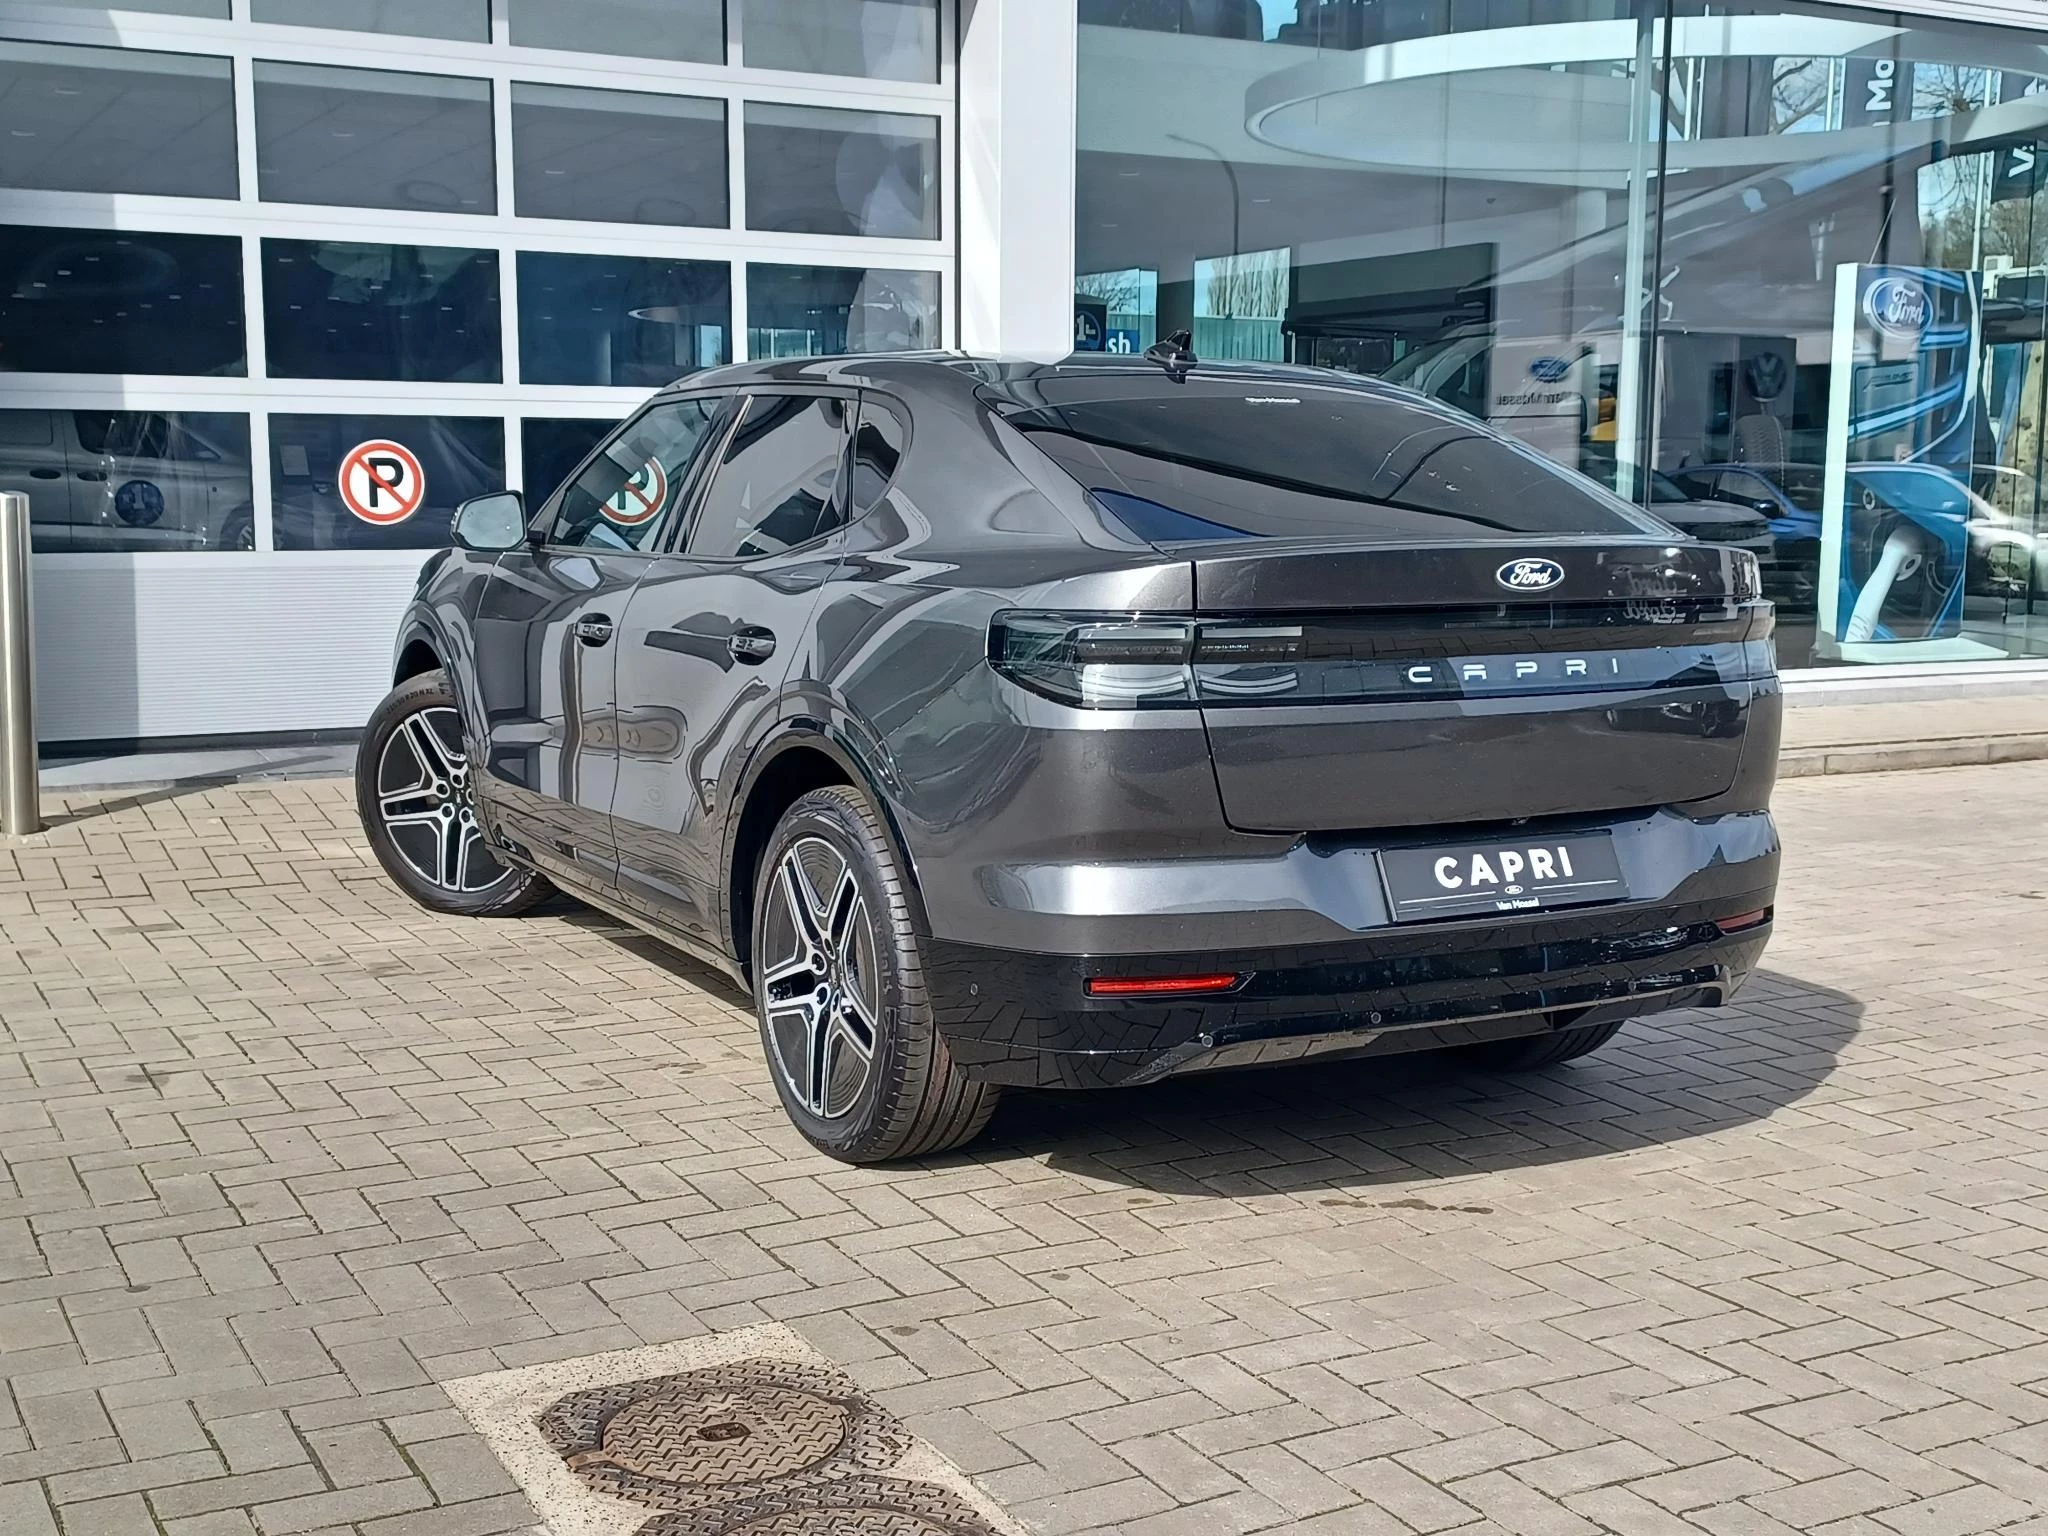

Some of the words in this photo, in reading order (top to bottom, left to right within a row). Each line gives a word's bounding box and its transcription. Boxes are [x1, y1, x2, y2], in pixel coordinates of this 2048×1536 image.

[1509, 562, 1553, 585] Ford
[1407, 657, 1619, 684] CAPRI
[1434, 846, 1574, 889] CAPRI
